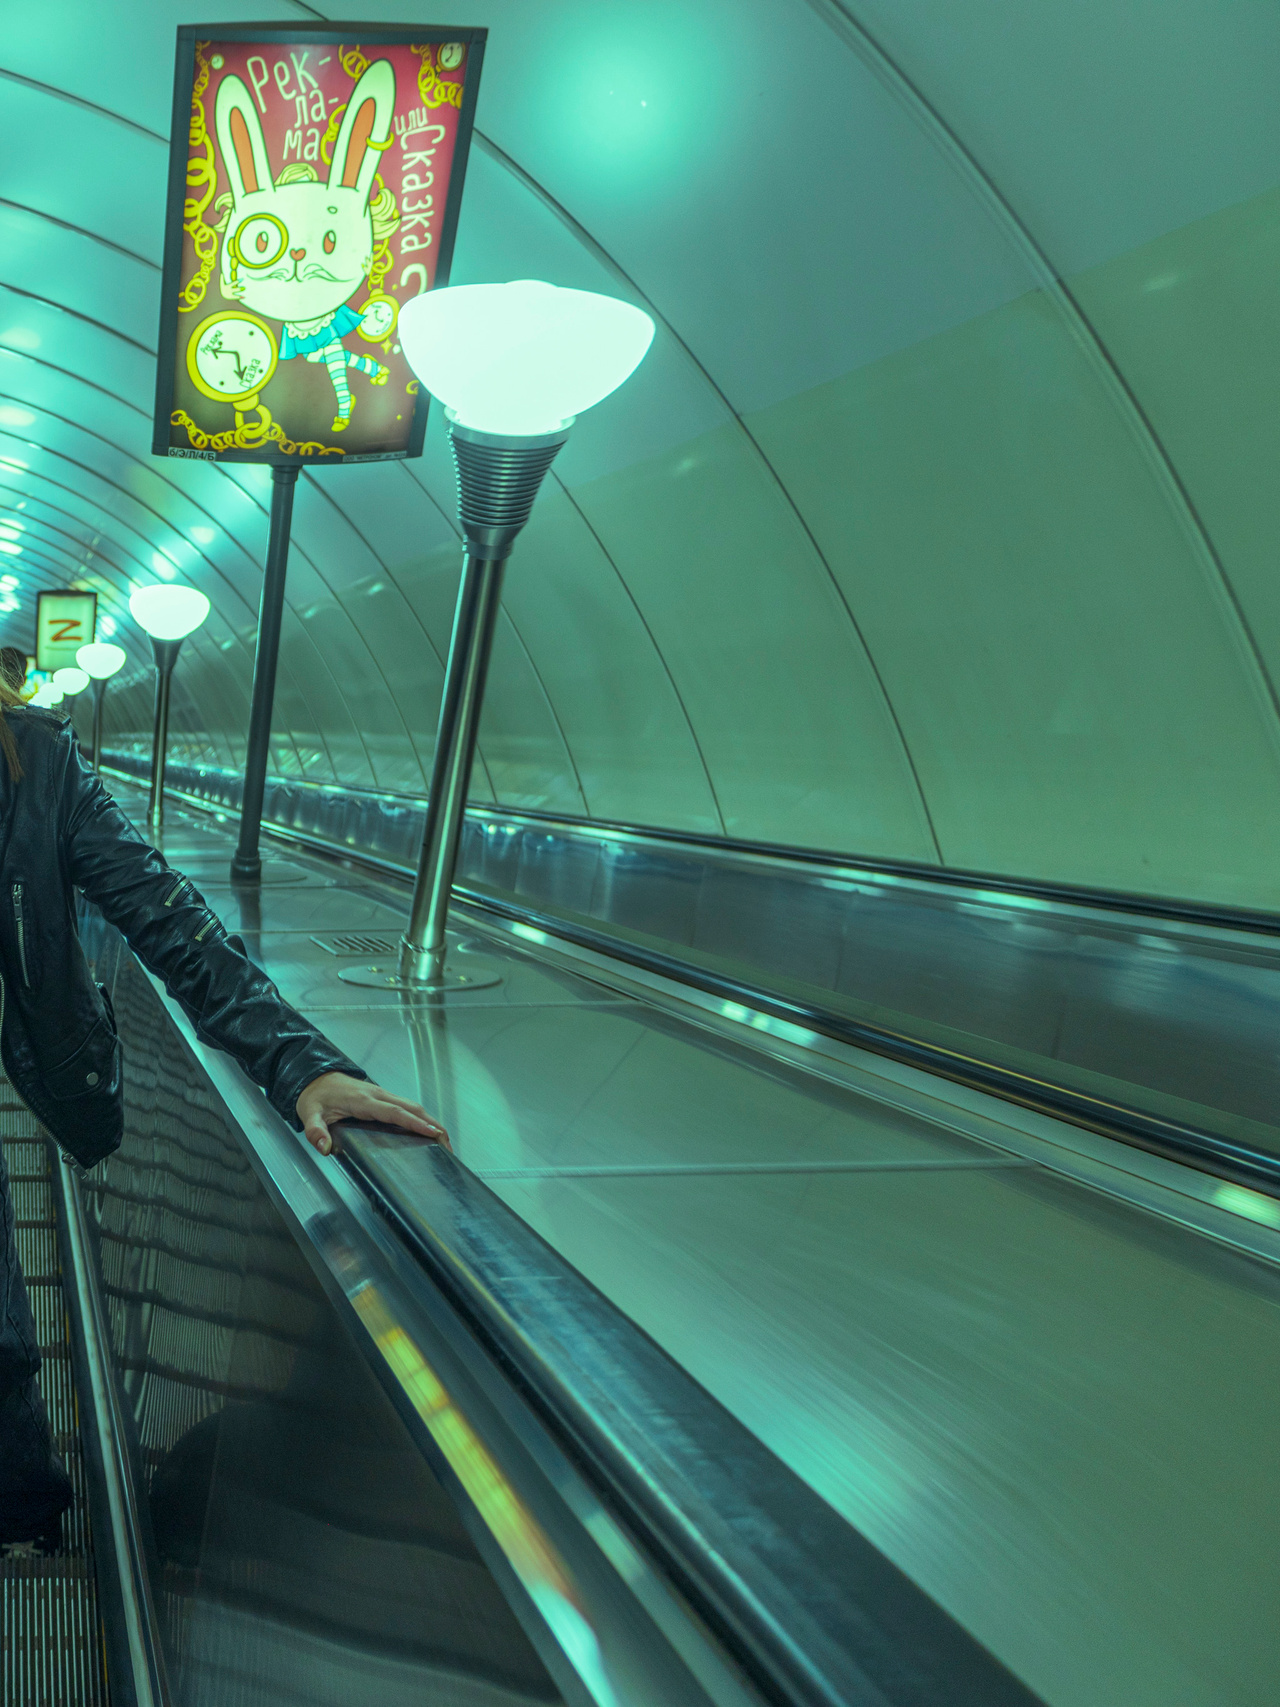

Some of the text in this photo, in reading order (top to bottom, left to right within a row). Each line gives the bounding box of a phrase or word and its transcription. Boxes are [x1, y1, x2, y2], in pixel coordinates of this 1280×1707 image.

[246, 50, 331, 114] Рек-
[294, 88, 339, 129] ла-
[394, 106, 429, 136] или
[282, 128, 321, 162] ма
[239, 358, 261, 389] Сказка
